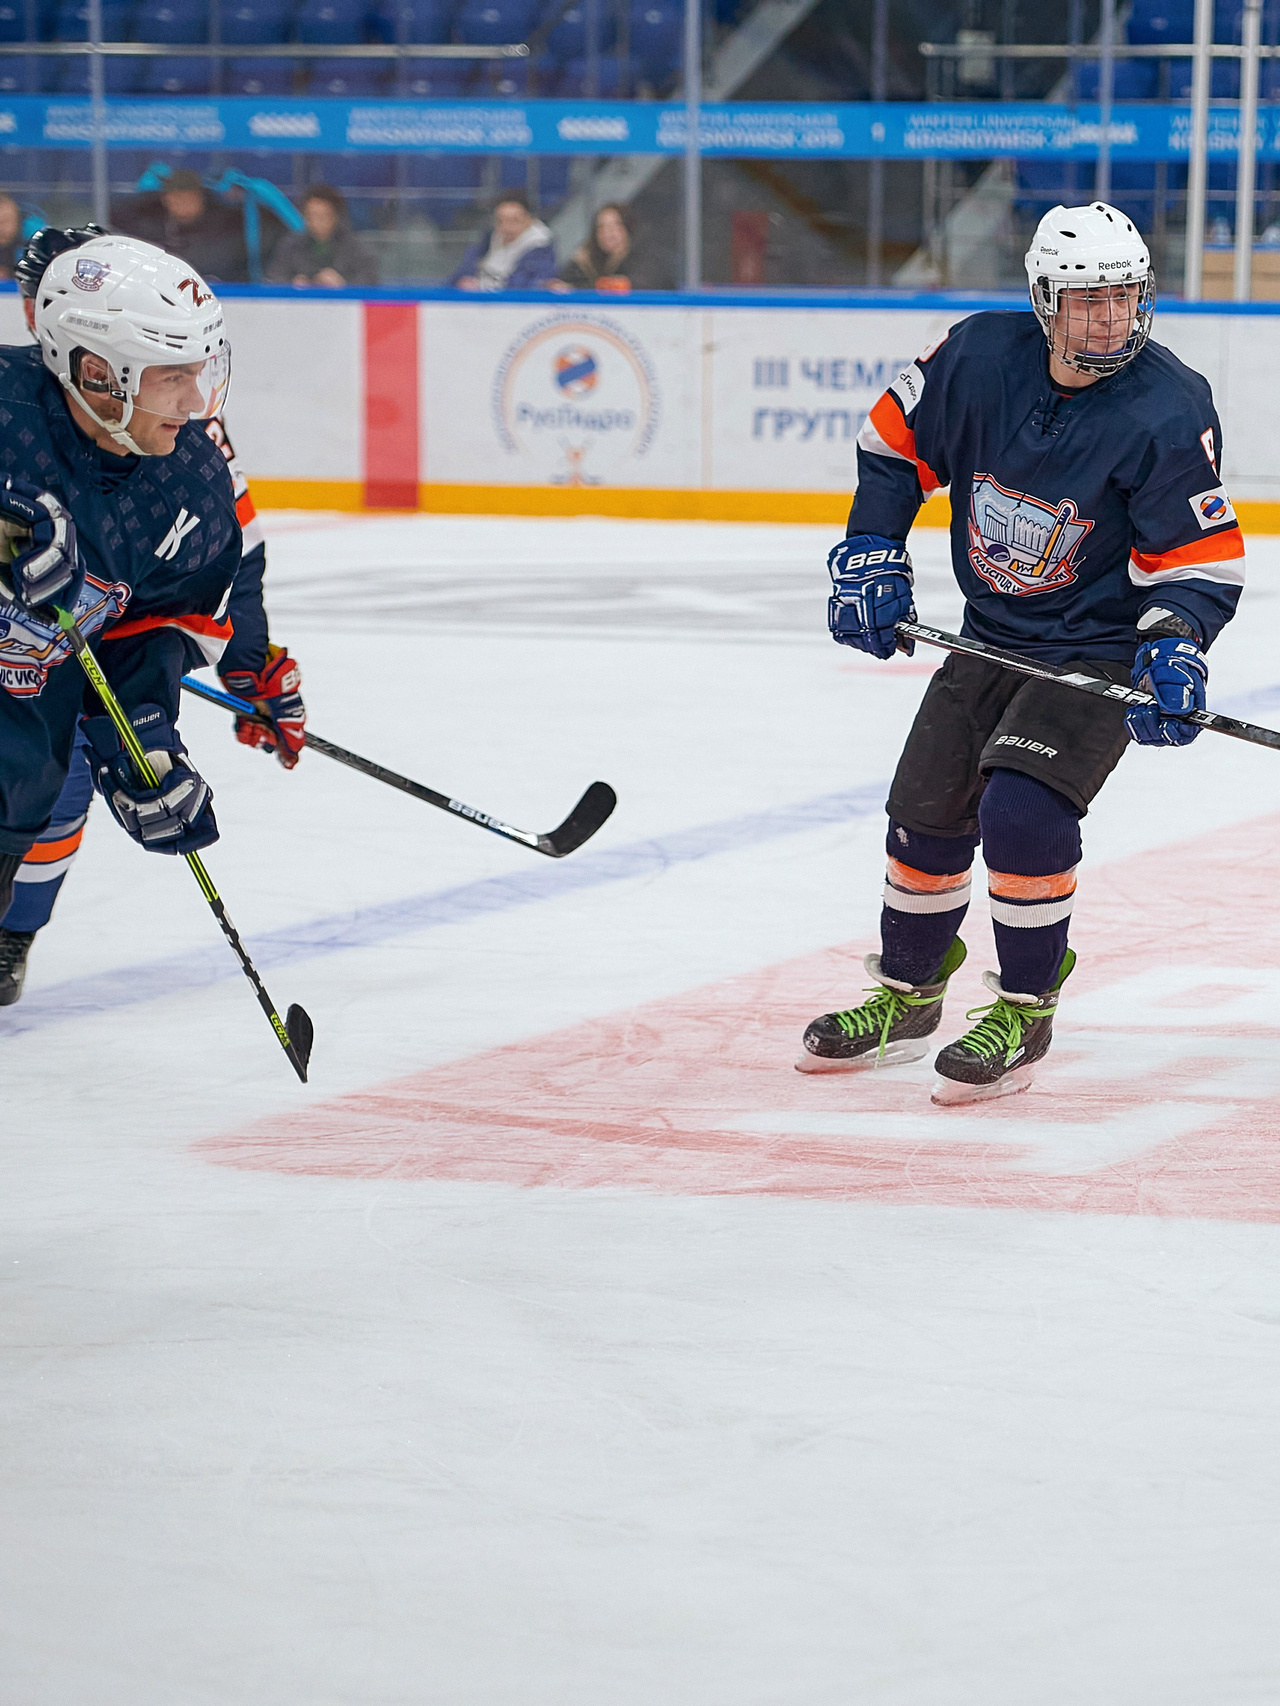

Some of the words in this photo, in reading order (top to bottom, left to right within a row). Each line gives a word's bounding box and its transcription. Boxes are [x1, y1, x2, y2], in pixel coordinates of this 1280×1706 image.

[1098, 260, 1133, 271] Reebok
[84, 657, 104, 686] CCM
[133, 711, 161, 727] BAUER
[994, 735, 1059, 759] BAUER
[448, 799, 503, 830] BAUE
